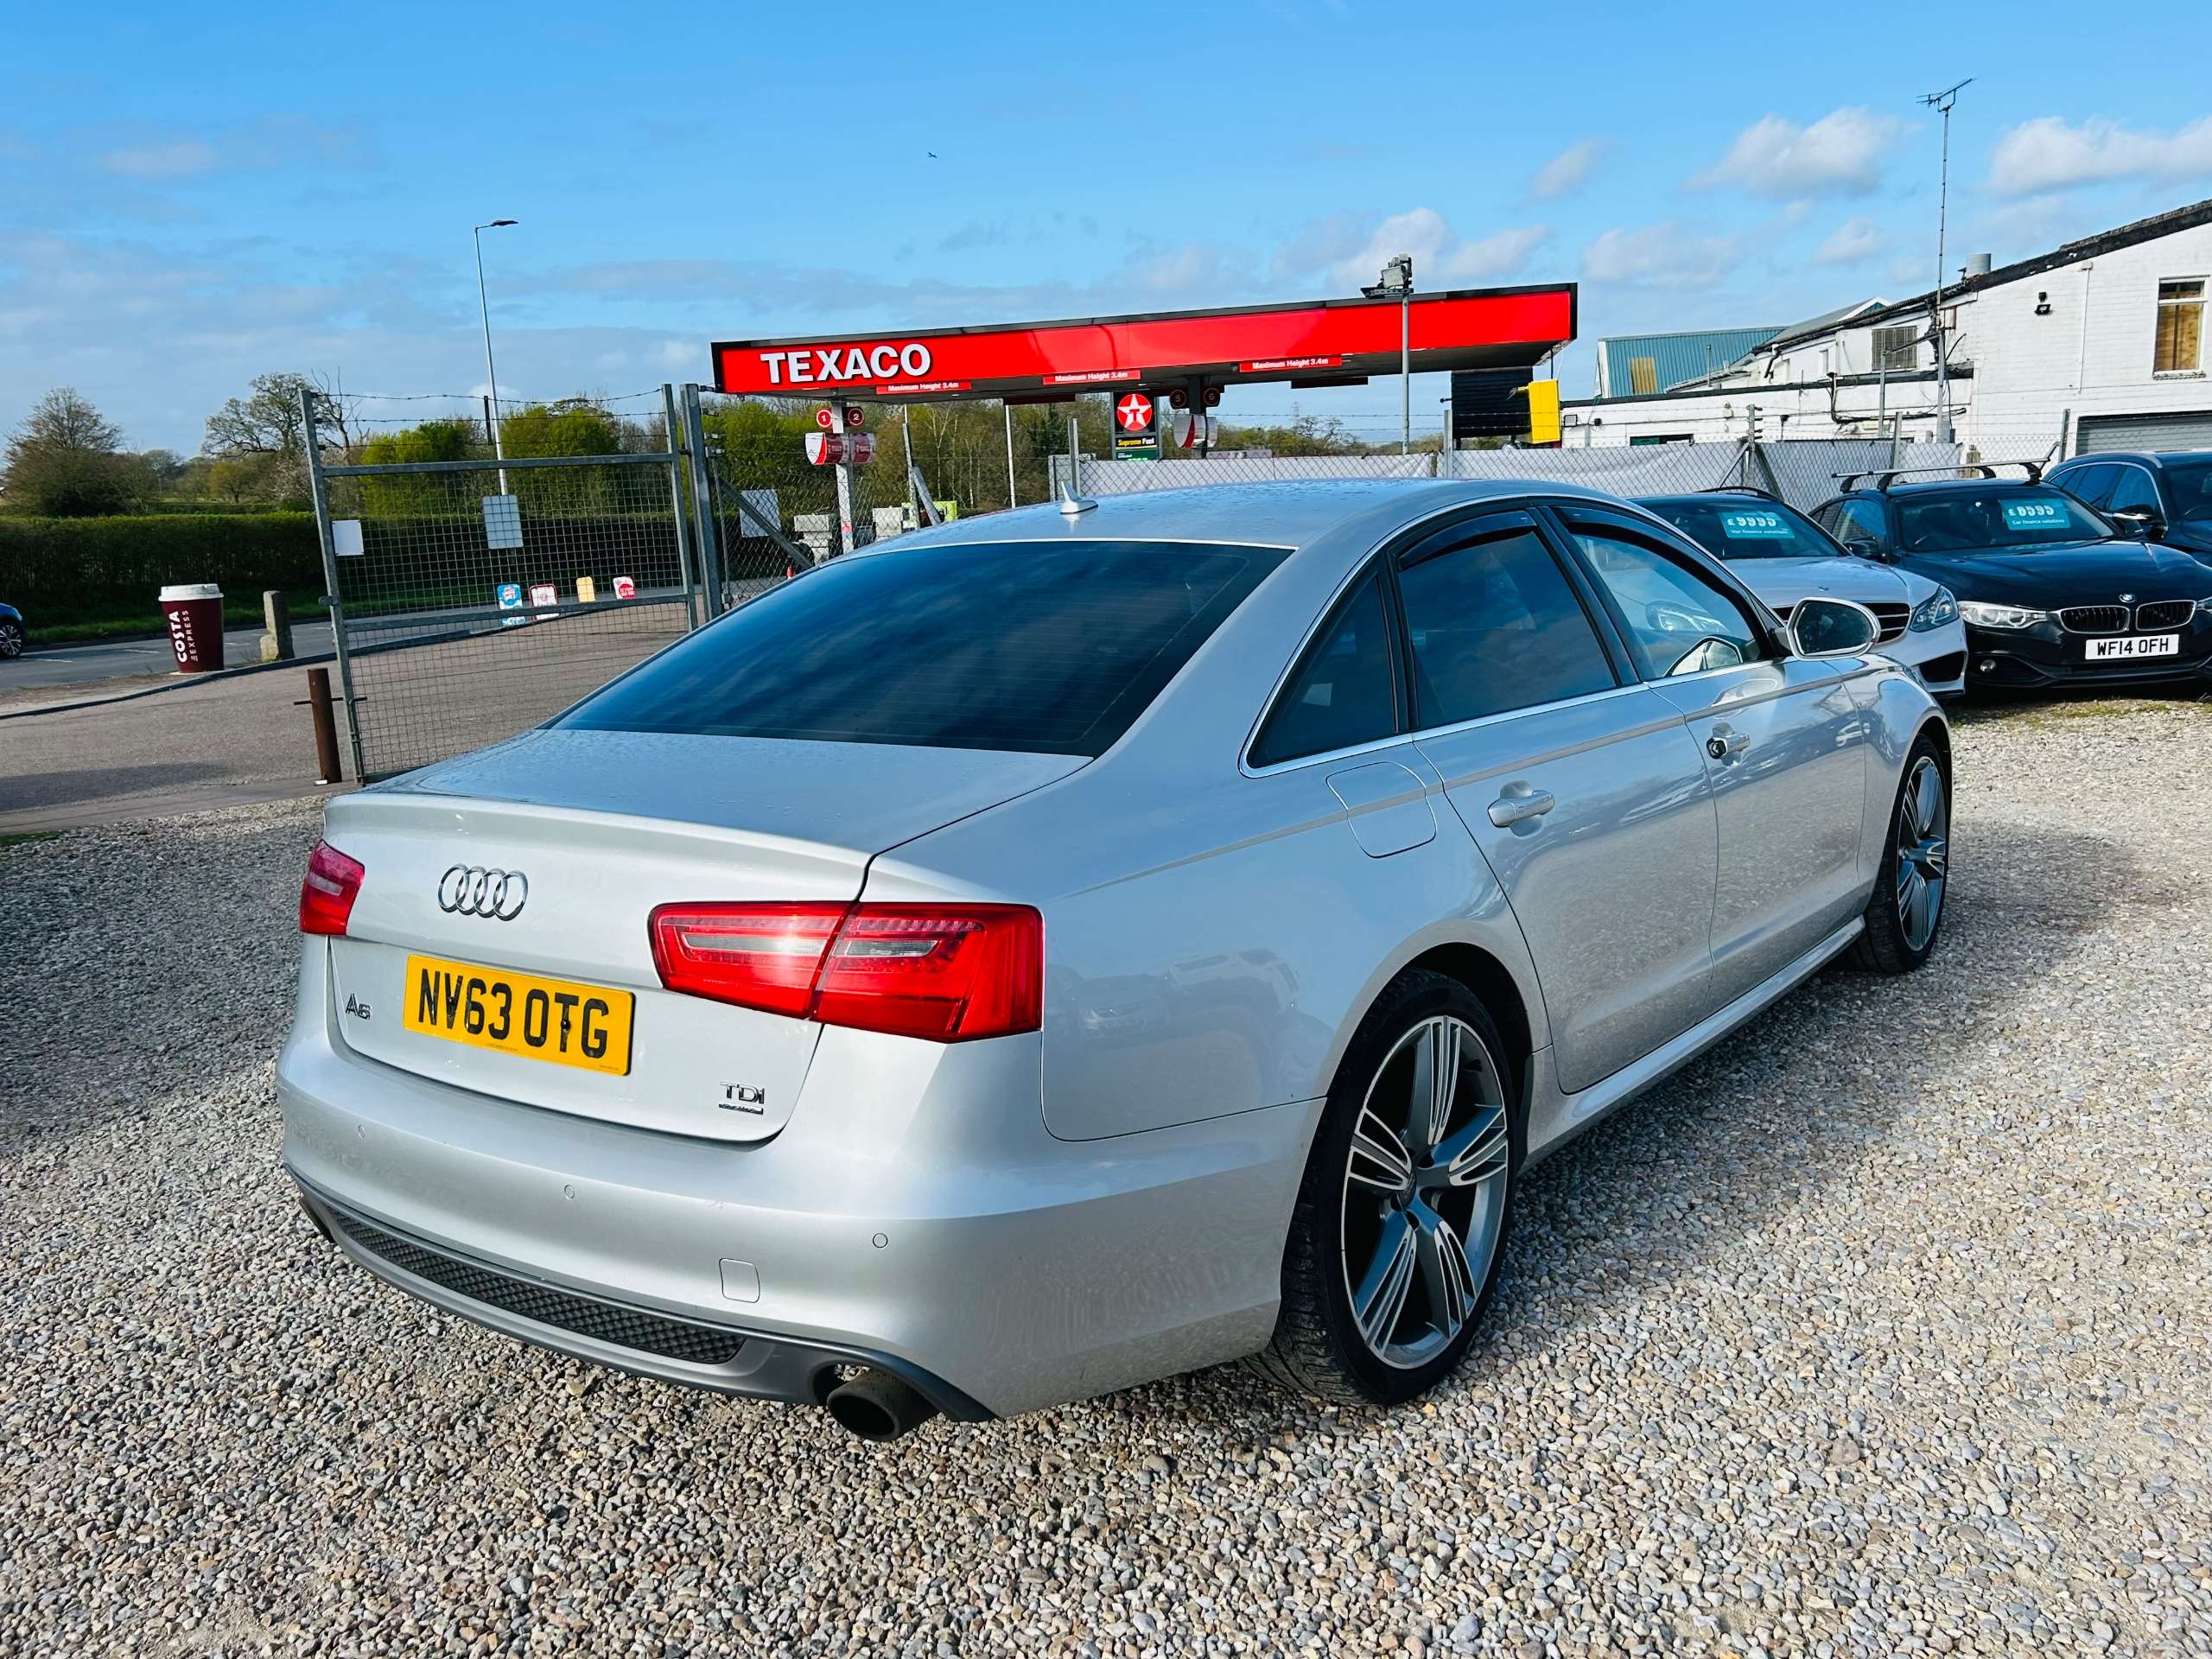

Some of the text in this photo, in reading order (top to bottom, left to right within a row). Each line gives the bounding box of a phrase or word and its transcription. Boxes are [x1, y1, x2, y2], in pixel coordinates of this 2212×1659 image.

[760, 343, 931, 384] TEXACO
[1251, 361, 1286, 370] Maximum
[1287, 359, 1310, 368] Height
[168, 611, 188, 663] COSTA
[181, 610, 196, 654] EXPRESS
[2097, 638, 2169, 656] WF14 OFH
[346, 994, 371, 1020] A6
[418, 968, 609, 1059] NV63 OTG
